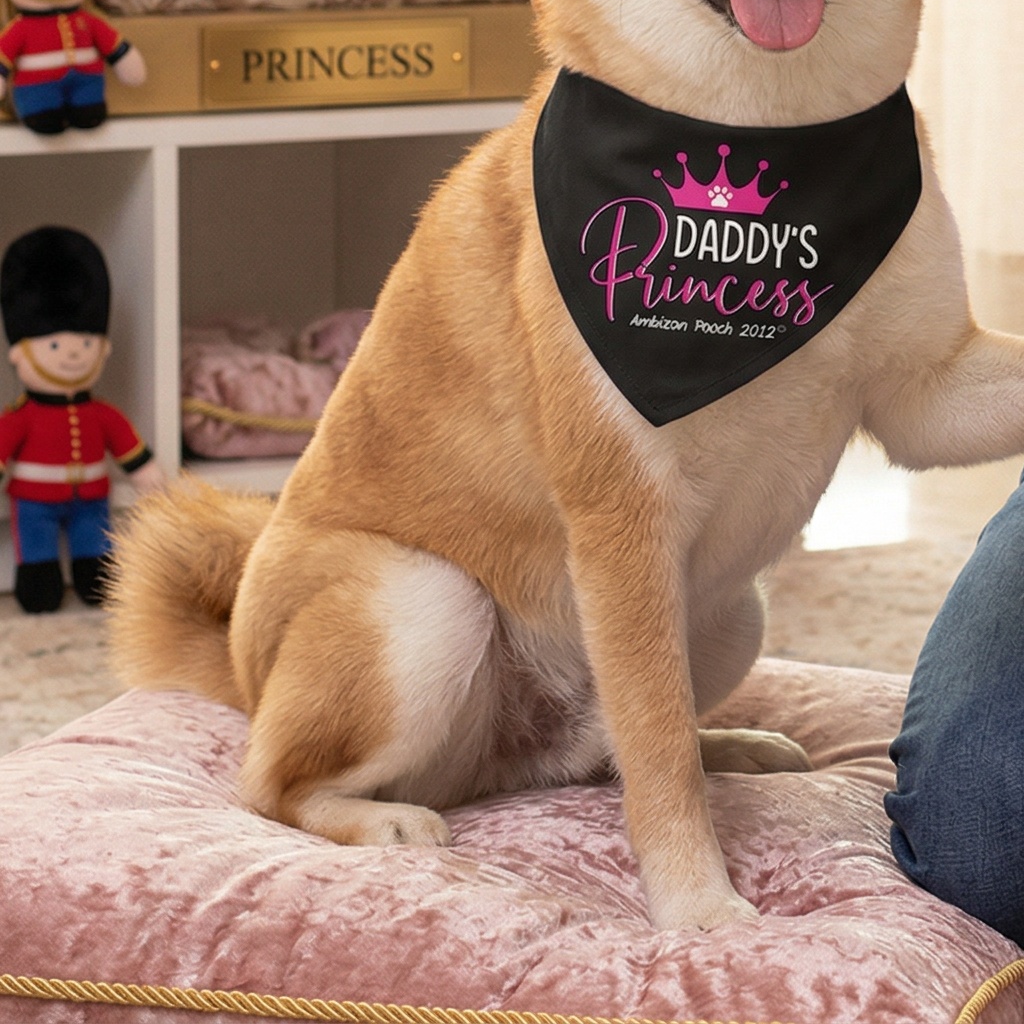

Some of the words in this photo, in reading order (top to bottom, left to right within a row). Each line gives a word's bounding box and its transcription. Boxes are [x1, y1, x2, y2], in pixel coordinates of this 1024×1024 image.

[241, 42, 434, 83] PRINCESS
[580, 196, 835, 326] Princess
[673, 214, 819, 269] DADDY'S
[629, 313, 688, 332] Ambizon
[694, 319, 734, 336] Pooch
